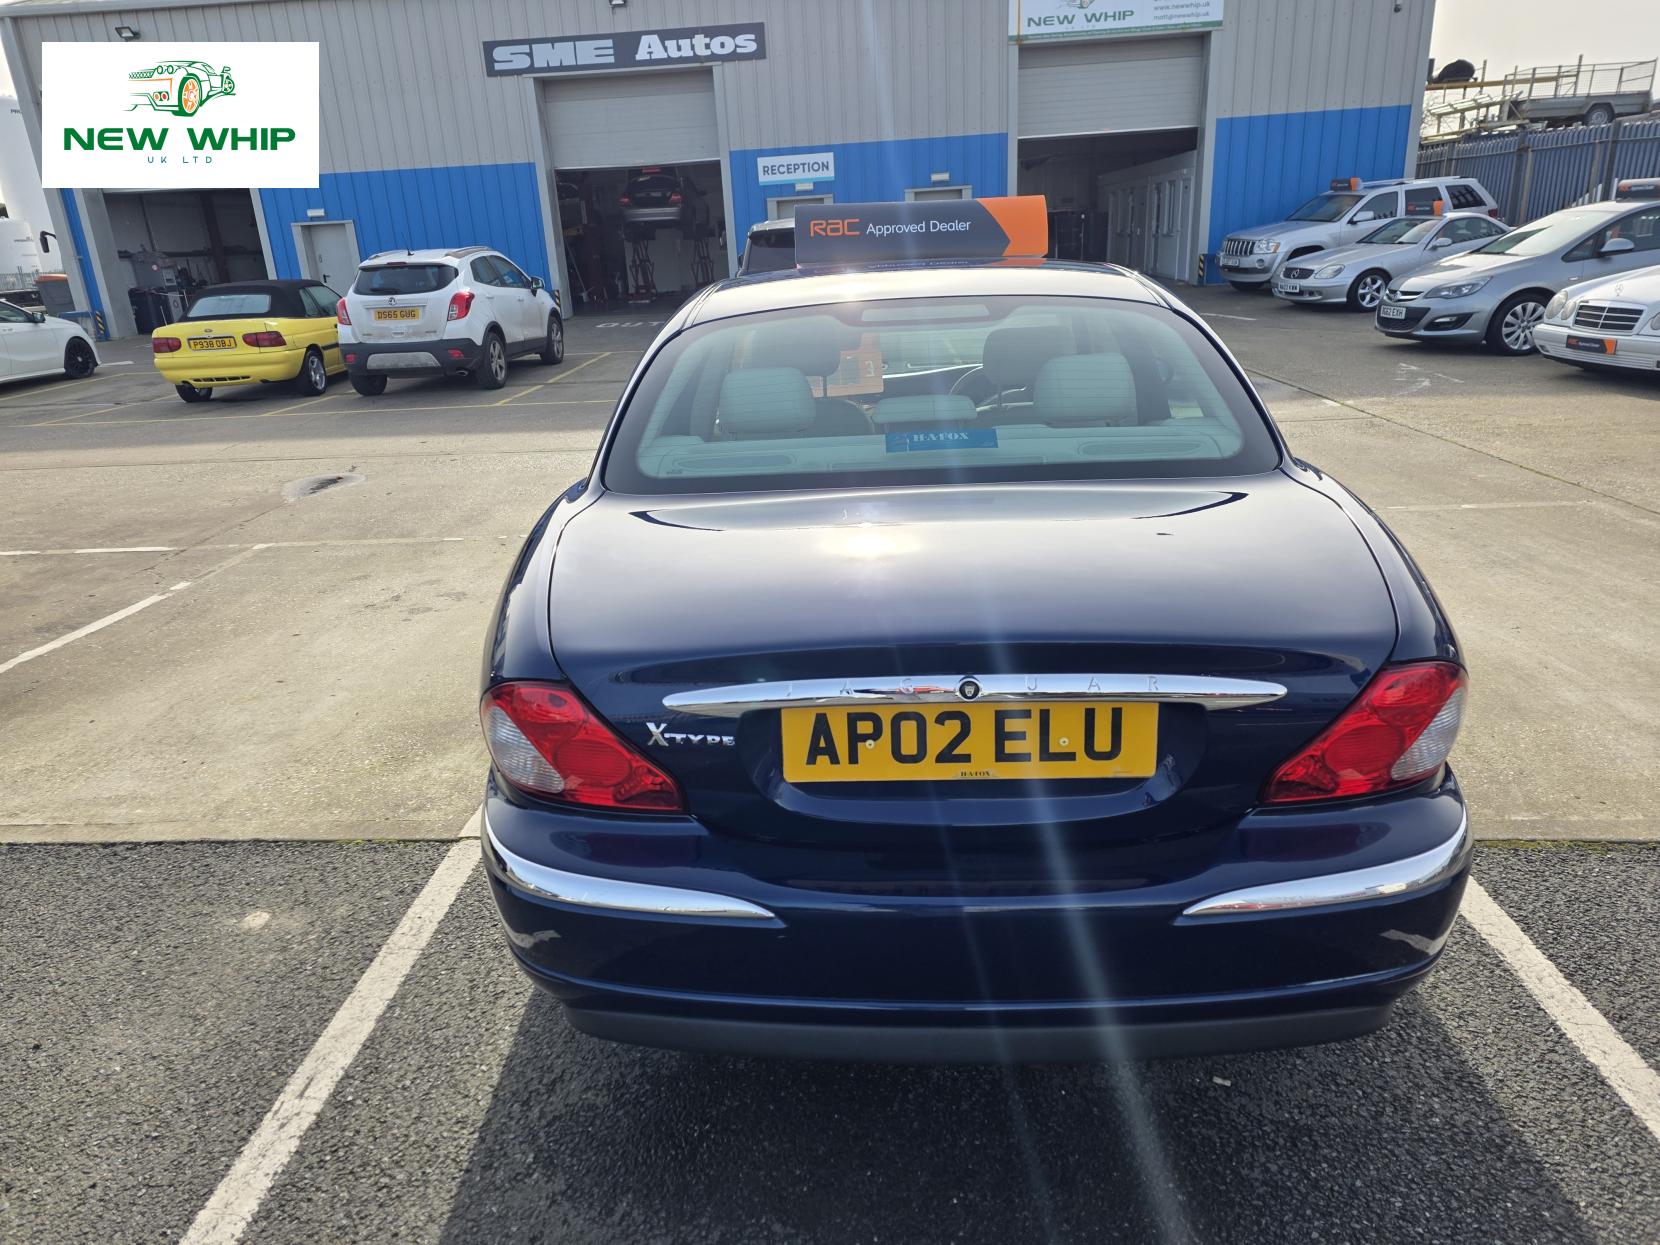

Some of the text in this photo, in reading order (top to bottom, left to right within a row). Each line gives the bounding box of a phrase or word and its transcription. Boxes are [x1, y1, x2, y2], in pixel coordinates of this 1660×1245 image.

[1027, 10, 1135, 28] NEW WHIP
[492, 33, 758, 71] SME Autos
[762, 161, 830, 176] RECEPTION
[866, 221, 926, 238] Approved
[930, 220, 971, 233] Dealer
[193, 340, 215, 349] P938
[805, 707, 1123, 766] AP02 ELU
